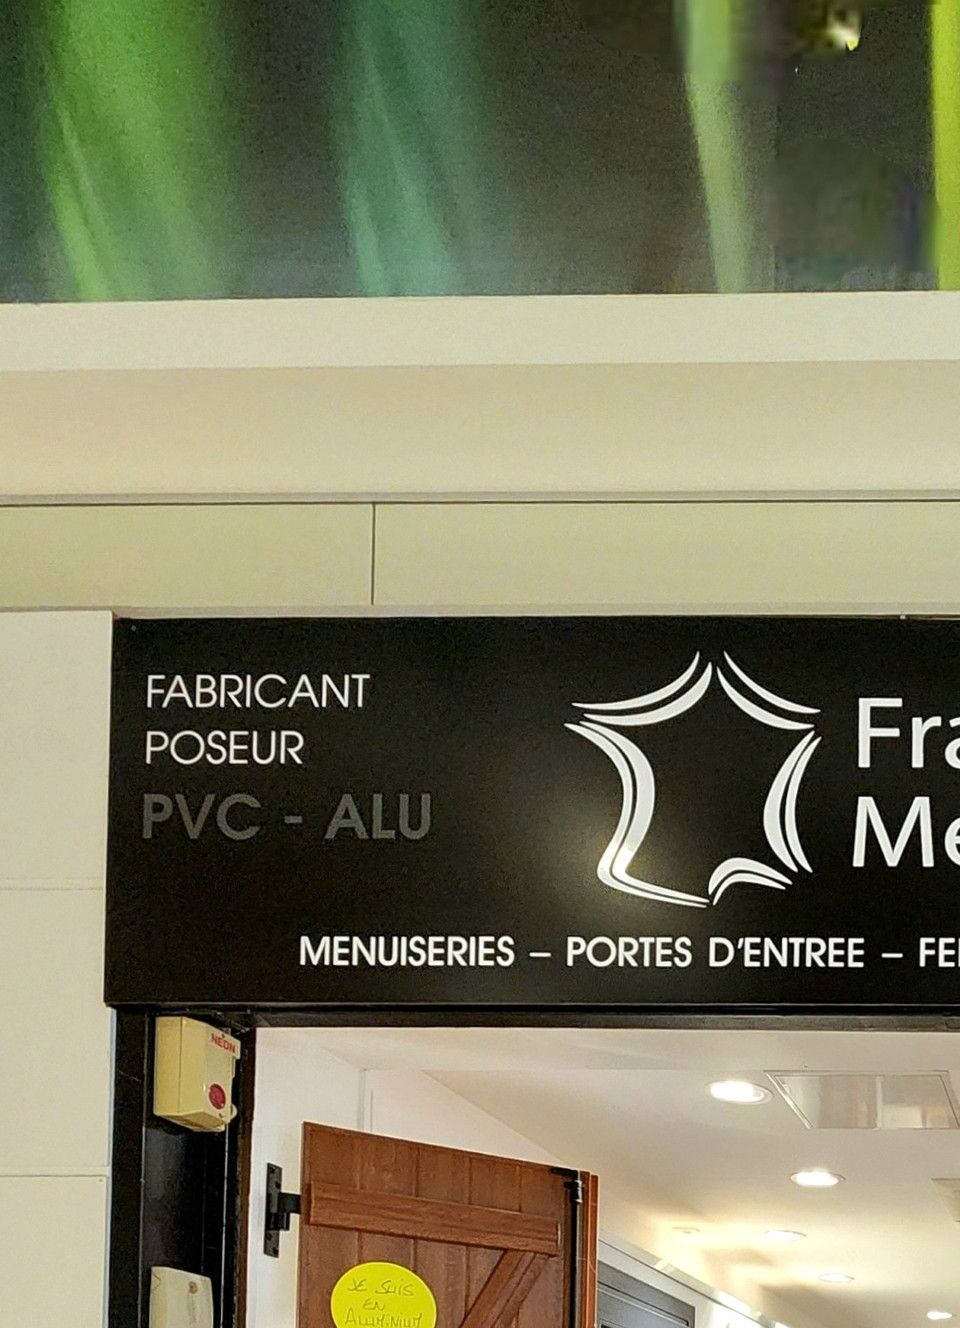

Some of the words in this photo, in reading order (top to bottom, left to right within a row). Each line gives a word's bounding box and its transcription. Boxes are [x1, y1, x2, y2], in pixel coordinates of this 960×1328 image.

[146, 673, 371, 709] FABRICANT
[145, 729, 304, 765] POSEUR
[143, 793, 261, 840] PVC
[324, 793, 431, 840] ALU
[299, 935, 515, 967] MENUISERIES
[566, 936, 693, 968] PORTES
[709, 936, 865, 968] D'ENTREE
